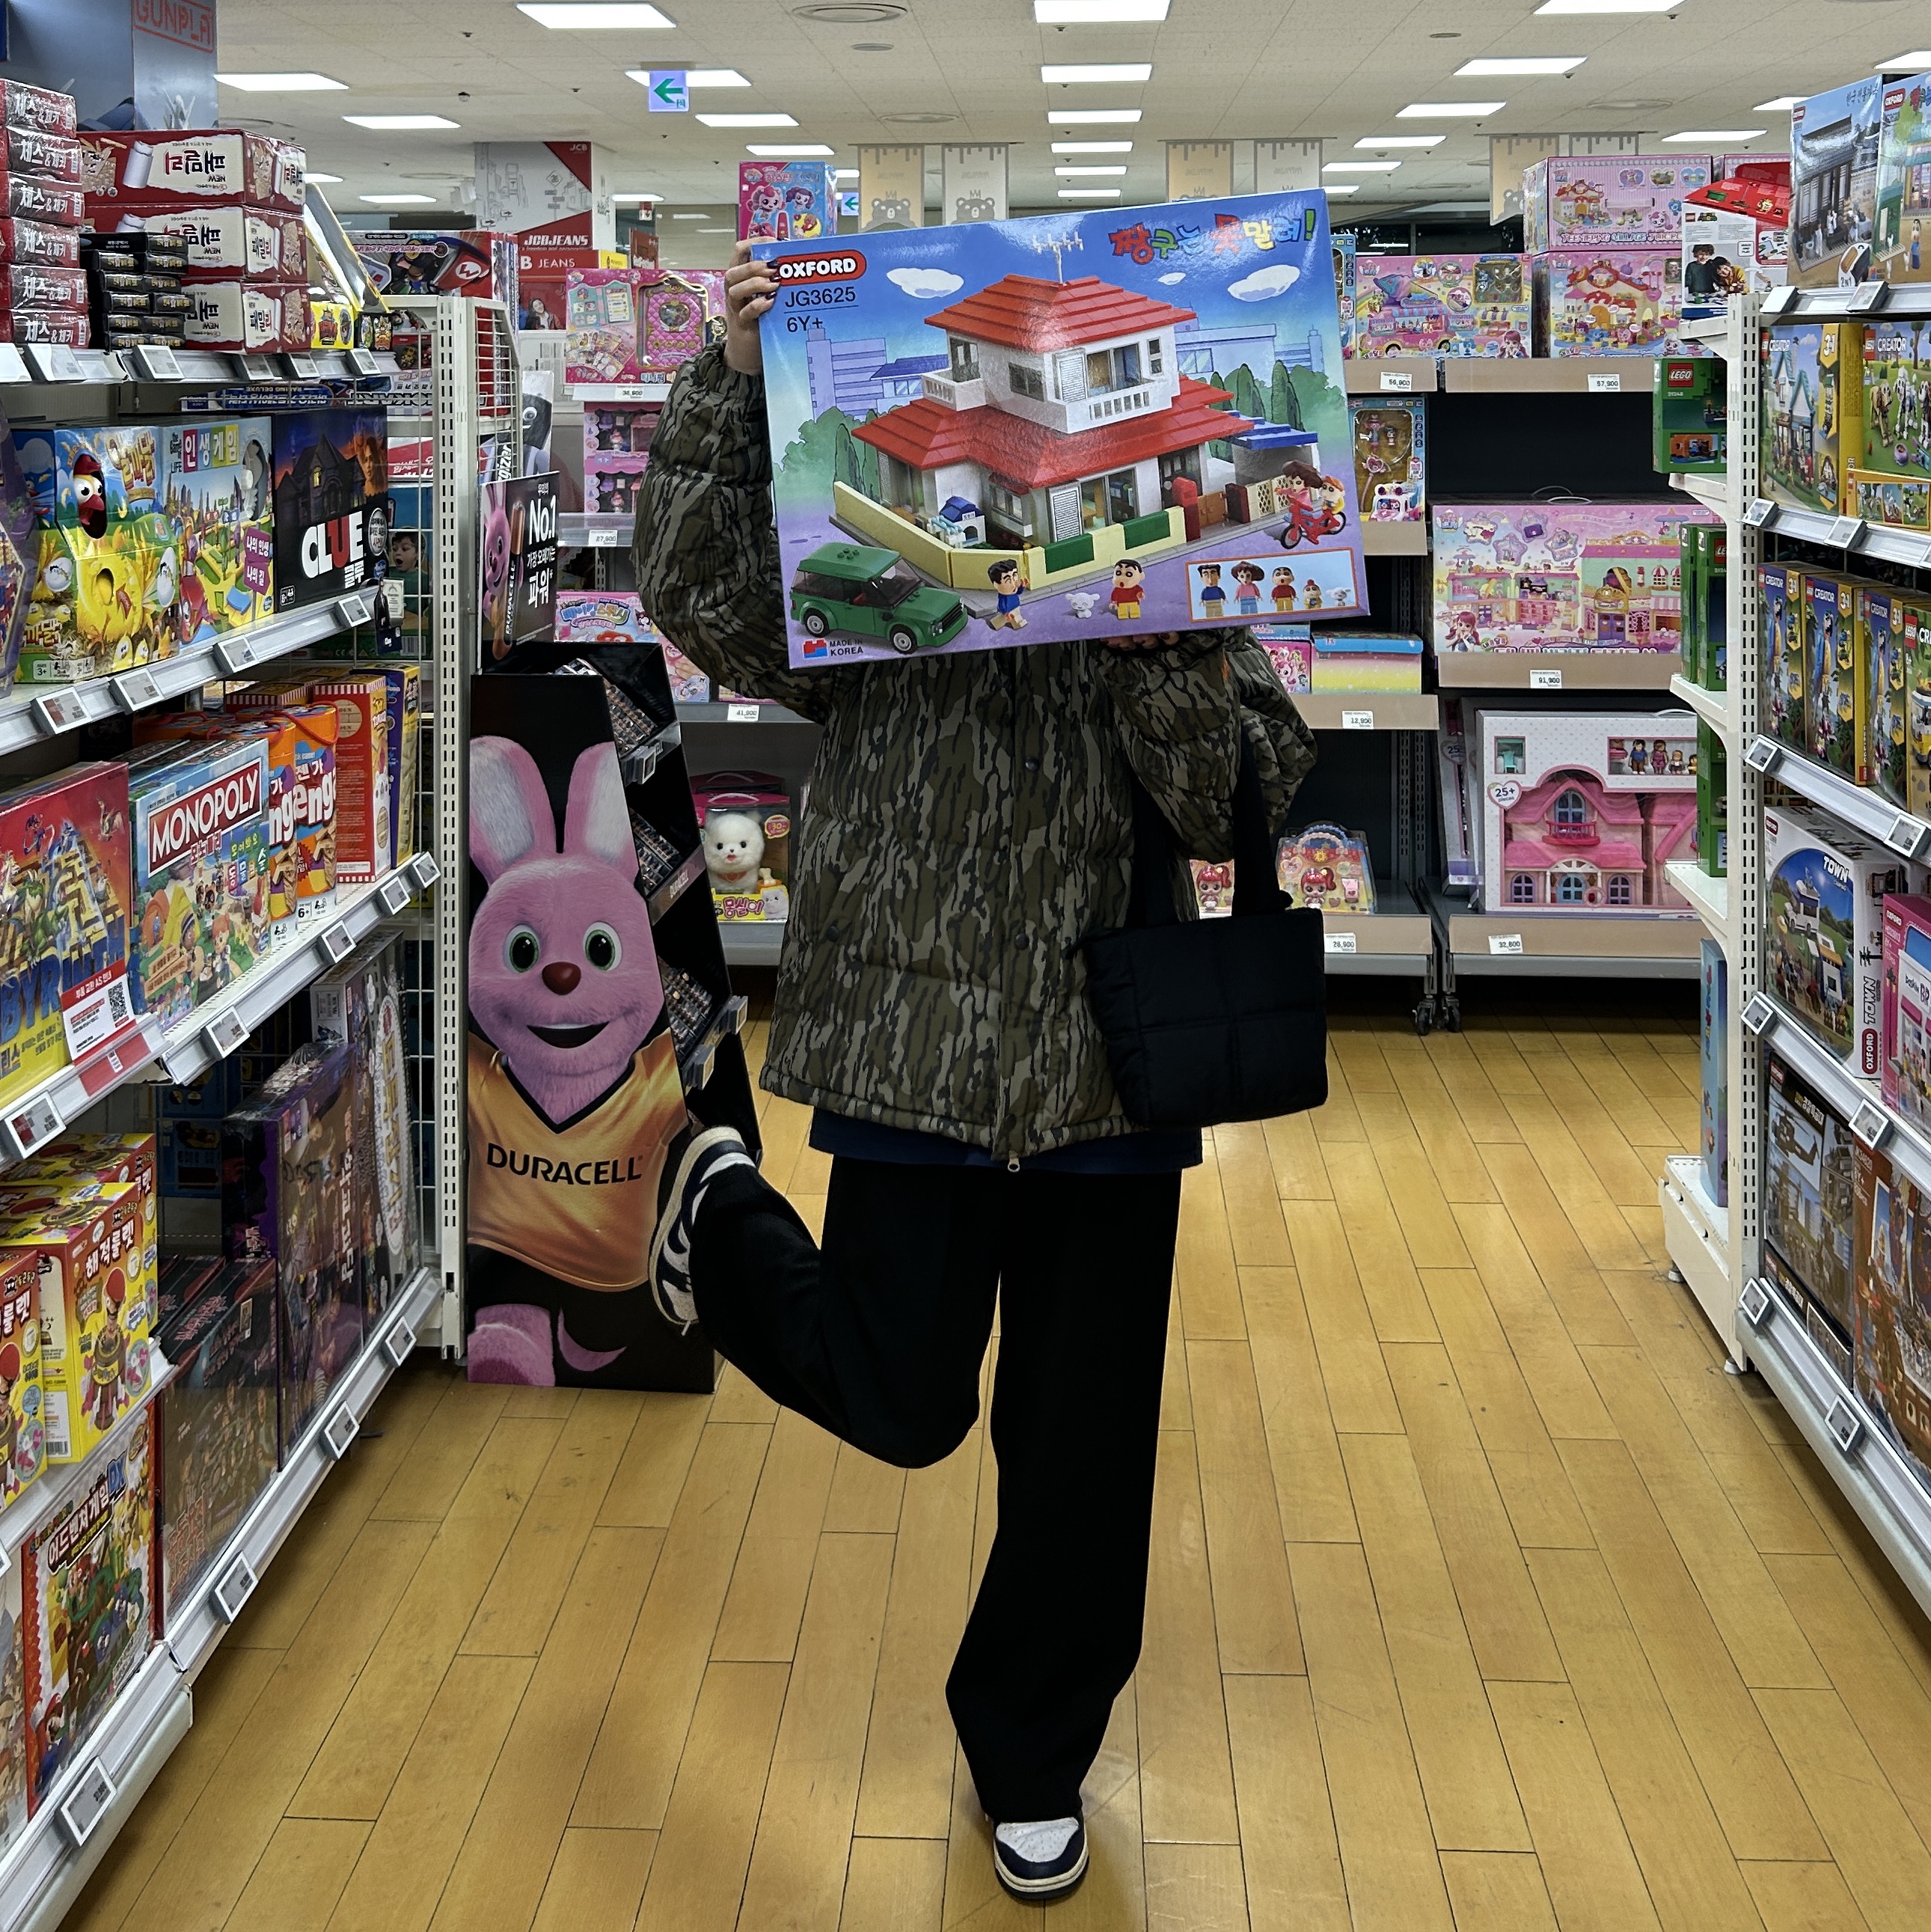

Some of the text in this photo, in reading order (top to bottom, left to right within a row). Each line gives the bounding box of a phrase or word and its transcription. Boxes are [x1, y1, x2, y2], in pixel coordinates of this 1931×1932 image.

[135, 0, 211, 46] GUNPLA
[165, 150, 225, 175] 패밀리
[1108, 223, 1201, 265] 짱구는
[539, 257, 575, 269] JEANS
[780, 257, 856, 278] OXFORD
[785, 286, 856, 308] JG3625
[787, 316, 823, 332] 6Y+
[1877, 337, 1908, 352] CREATOR
[1669, 369, 1692, 381] LEGO
[184, 427, 238, 468] 인생게임
[529, 497, 556, 545] No.1
[247, 536, 257, 550] 나의
[302, 511, 364, 578] CLUE
[527, 551, 537, 569] 가장
[247, 566, 257, 583] 나의
[345, 560, 364, 589] 클루
[528, 571, 549, 608] 파워
[1814, 587, 1834, 604] CREATOR
[829, 638, 863, 648] MADE IN
[830, 646, 864, 657] KOREA
[296, 757, 323, 780] 젠가
[1495, 788, 1515, 798] 25+
[152, 769, 257, 862] MONOPOLY
[1823, 856, 1849, 883] TOWN
[298, 908, 310, 918] 6+
[723, 896, 765, 919] 몽실이
[95, 976, 102, 988] AS
[1863, 976, 1877, 1024] TOWN
[1865, 1032, 1875, 1071] OXFORD
[487, 1143, 642, 1185] DURACELL
[86, 1219, 135, 1280] 해적룰렛
